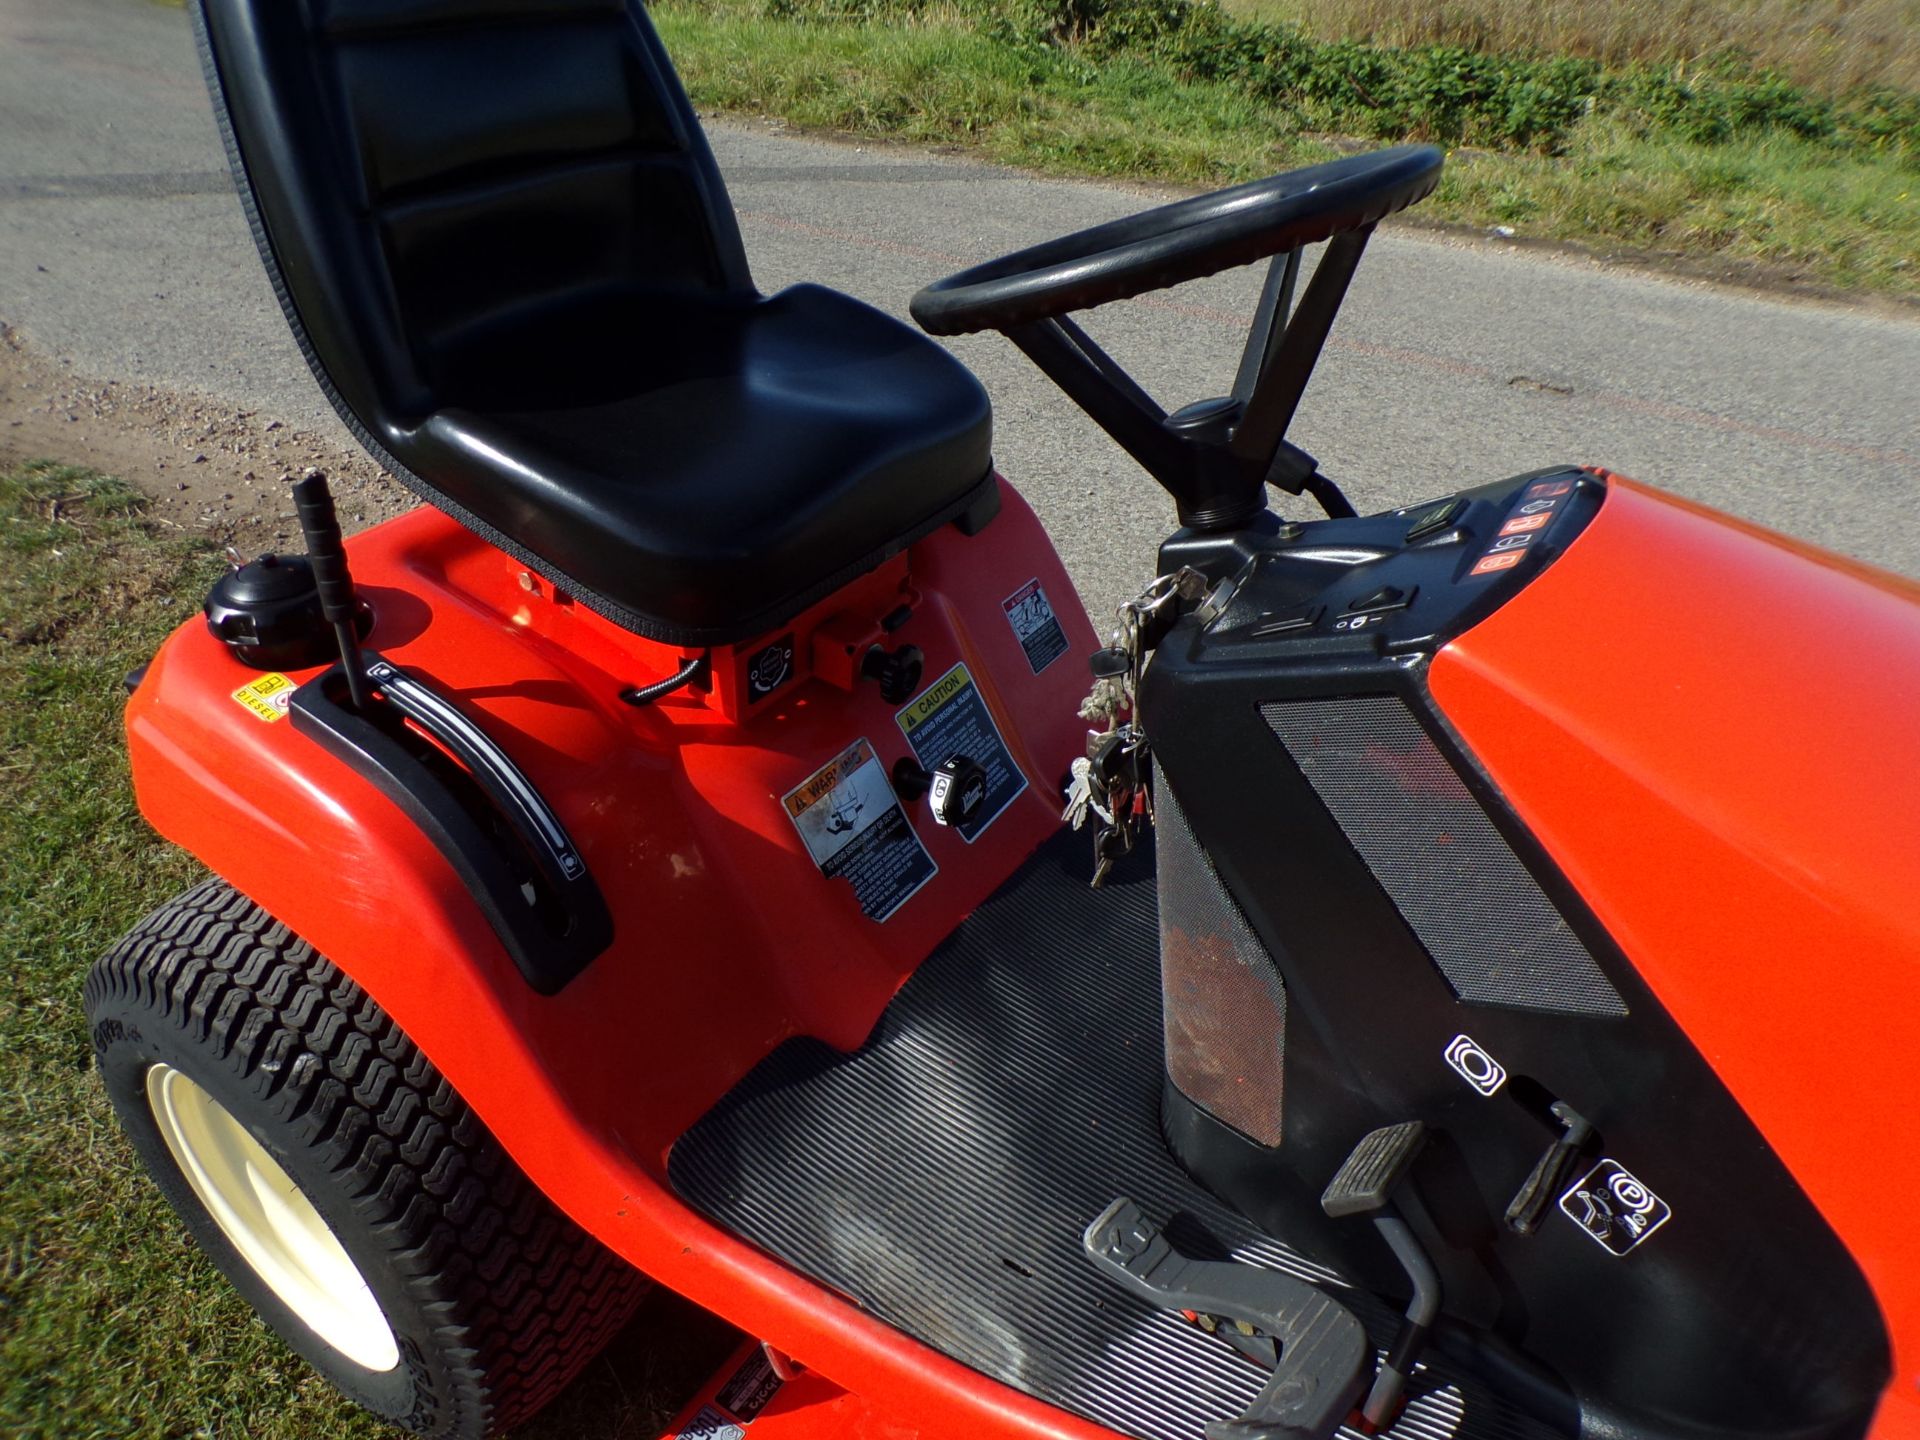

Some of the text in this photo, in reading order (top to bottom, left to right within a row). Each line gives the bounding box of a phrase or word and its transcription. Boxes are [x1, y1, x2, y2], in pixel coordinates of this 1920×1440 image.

[237, 690, 275, 720] DIESEL
[918, 673, 960, 714] CAUTION
[912, 687, 973, 743] TO AVOID PERSONAL INJURY
[1621, 1185, 1640, 1199] P
[691, 1411, 723, 1440] 105
